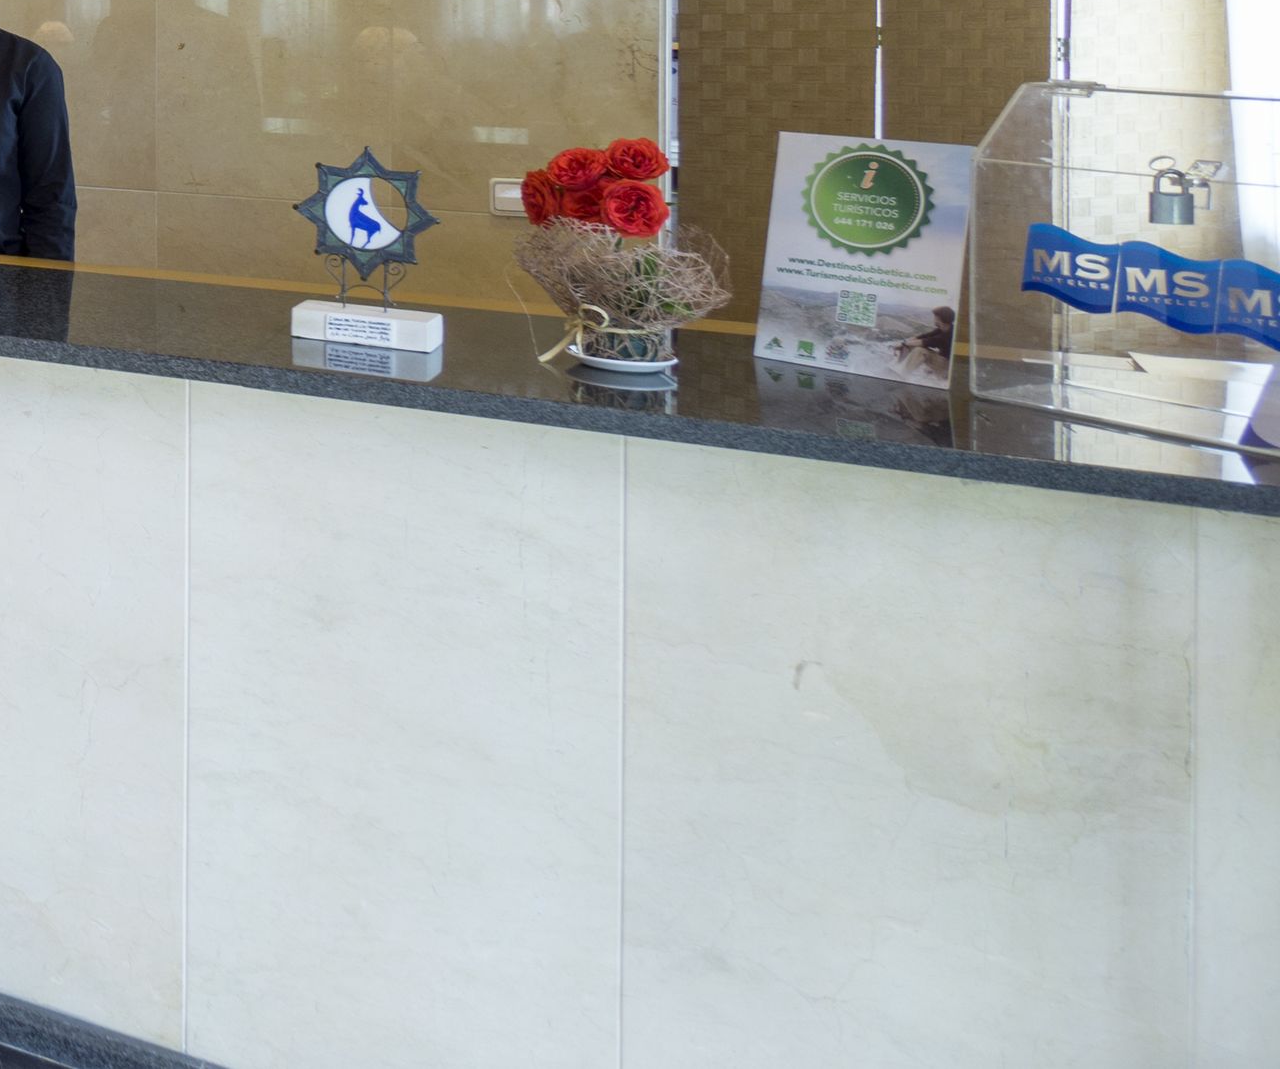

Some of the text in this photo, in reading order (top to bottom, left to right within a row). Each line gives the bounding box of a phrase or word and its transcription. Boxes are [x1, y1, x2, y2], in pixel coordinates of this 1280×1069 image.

[836, 191, 897, 206] SERVICIOS
[831, 203, 900, 218] TURÍSTICOS
[1032, 248, 1111, 281] MS
[1032, 275, 1110, 290] HOTELES
[1124, 266, 1210, 298] MS
[1126, 294, 1210, 308] HOTELES
[1228, 286, 1280, 318] M
[1228, 316, 1279, 328] HOTE
